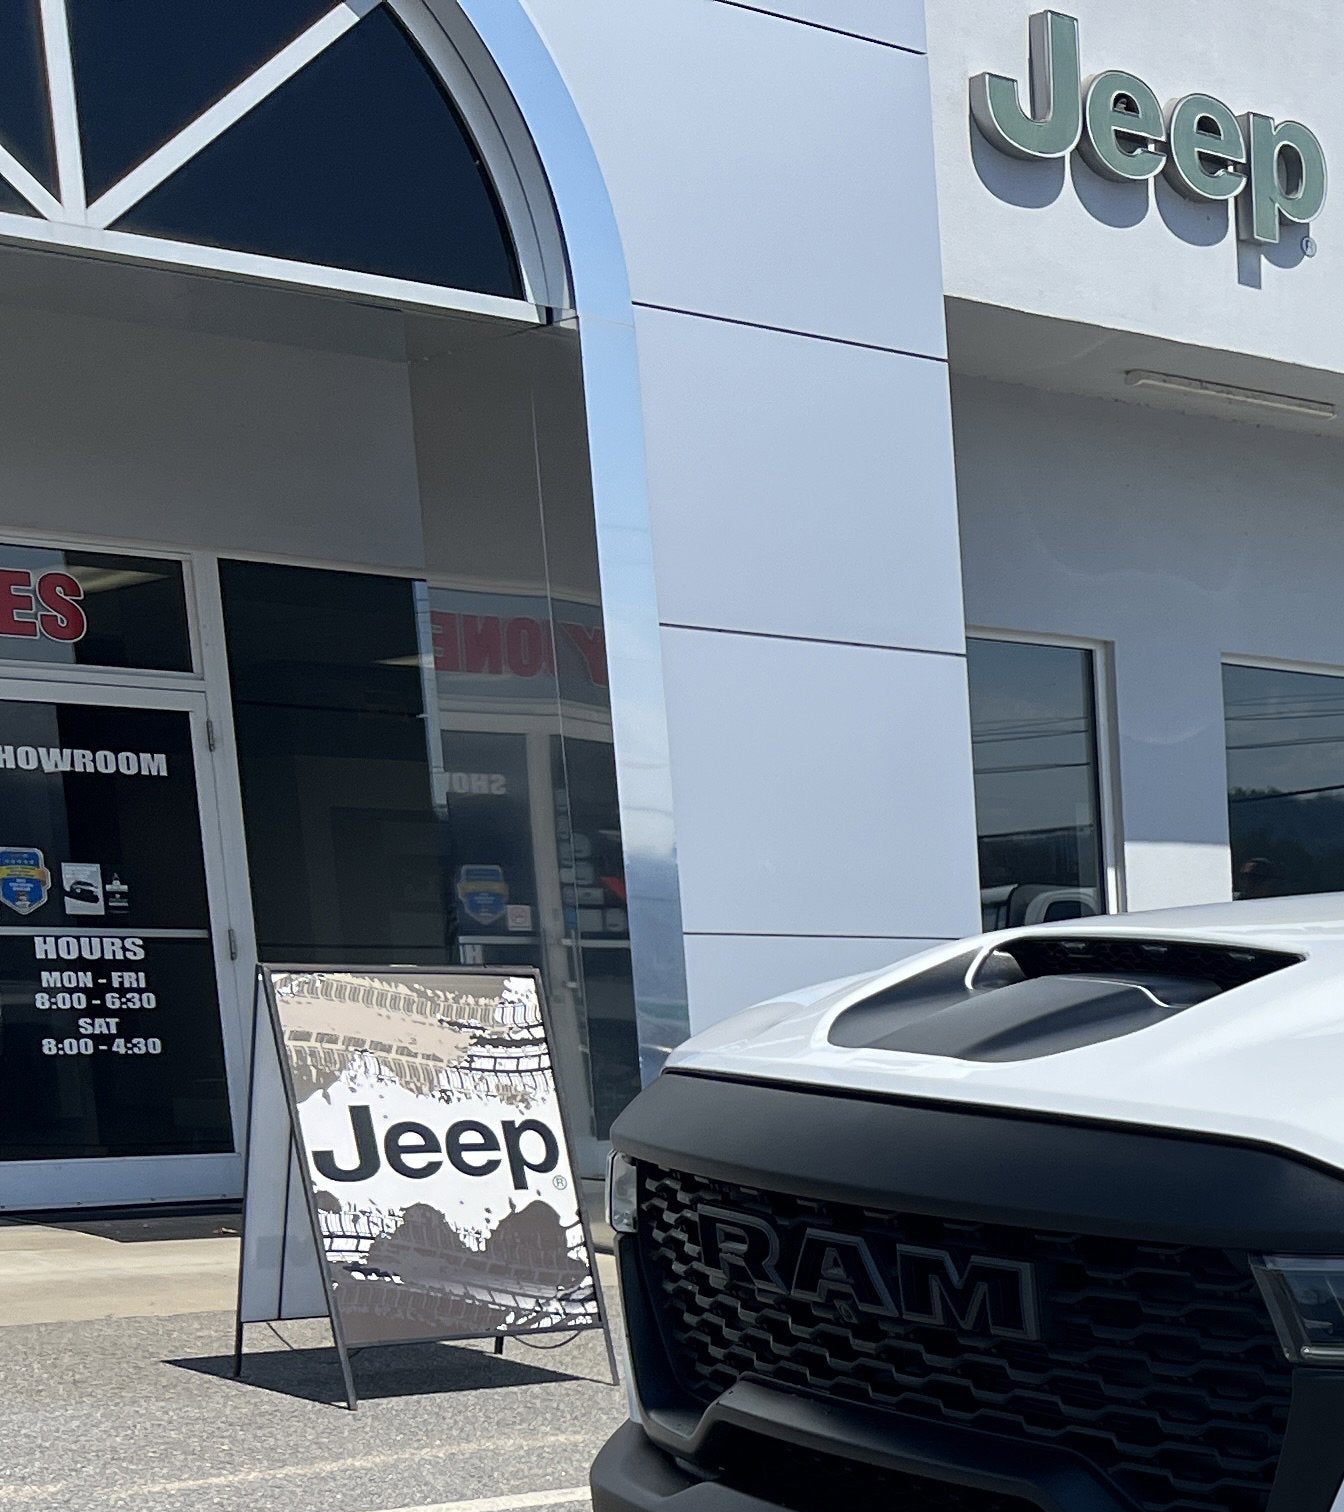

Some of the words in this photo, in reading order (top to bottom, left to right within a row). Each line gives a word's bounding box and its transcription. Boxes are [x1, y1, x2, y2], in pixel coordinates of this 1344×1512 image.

[969, 9, 1328, 244] Jeep
[33, 936, 146, 961] HOURS
[40, 971, 94, 988] MON
[111, 971, 147, 988] FRI
[34, 992, 87, 1010] 8:00
[104, 992, 157, 1010] 6:30
[77, 1017, 121, 1034] SAT
[41, 1038, 94, 1055] 8:00
[111, 1038, 162, 1055] 4:30
[311, 1104, 560, 1191] Jeep
[697, 1203, 1042, 1342] RAM
